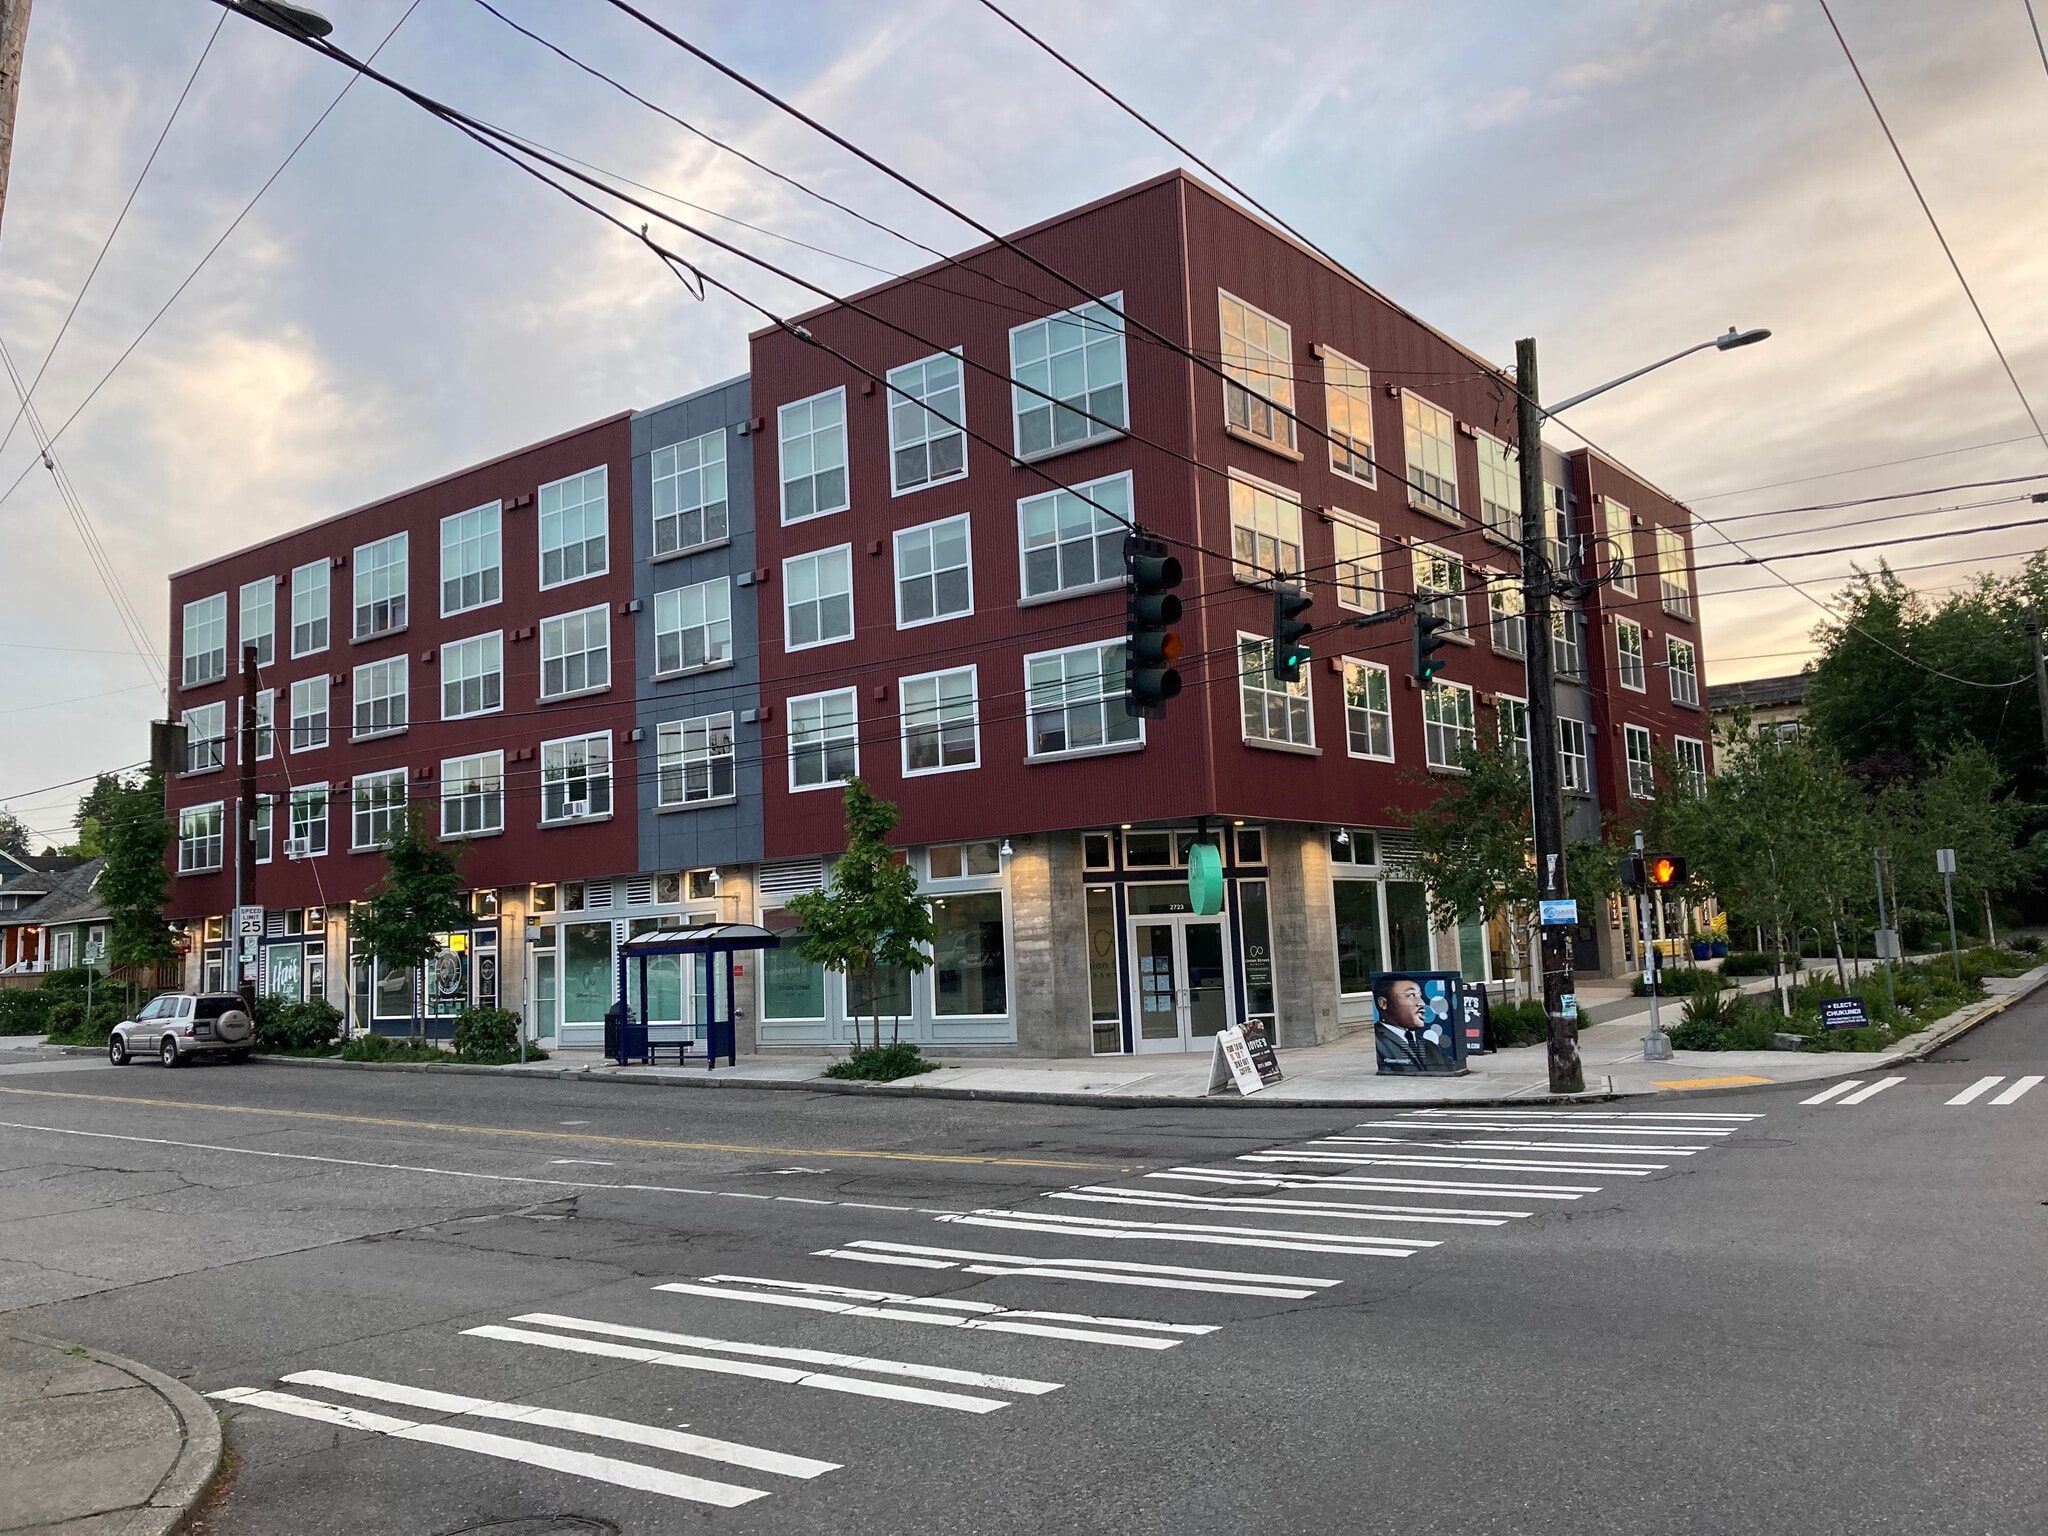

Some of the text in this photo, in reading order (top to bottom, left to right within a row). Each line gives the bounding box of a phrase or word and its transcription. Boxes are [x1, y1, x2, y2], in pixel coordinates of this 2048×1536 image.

[241, 921, 261, 933] 25
[272, 958, 299, 992] Hair
[1239, 1066, 1252, 1075] COFFEE
